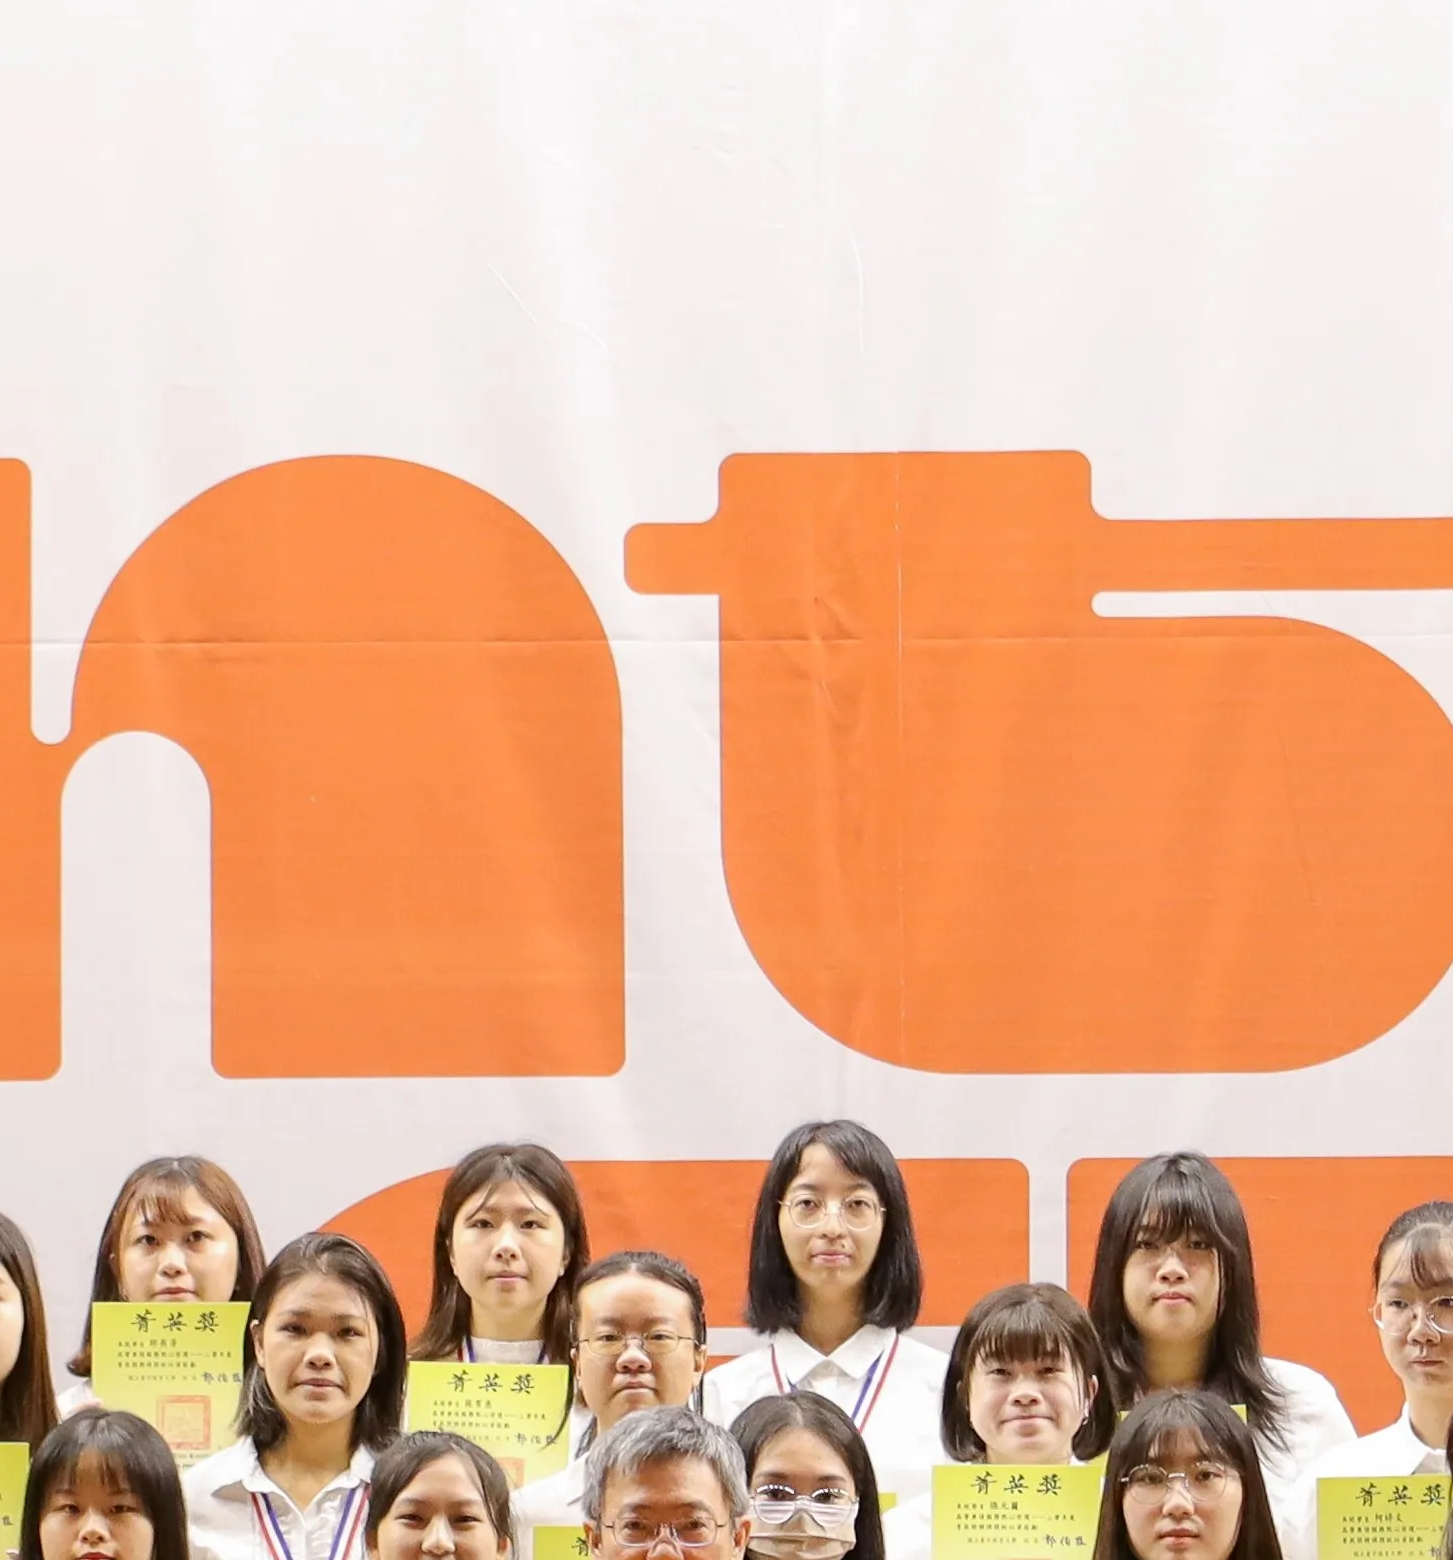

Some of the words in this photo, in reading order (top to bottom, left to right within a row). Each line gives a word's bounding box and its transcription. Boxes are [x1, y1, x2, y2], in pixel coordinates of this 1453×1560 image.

[131, 1308, 218, 1332] 菁英獎
[447, 1369, 535, 1394] 菁英獎
[971, 1471, 1062, 1495] 菁英獎
[1356, 1482, 1445, 1507] 菁英獎
